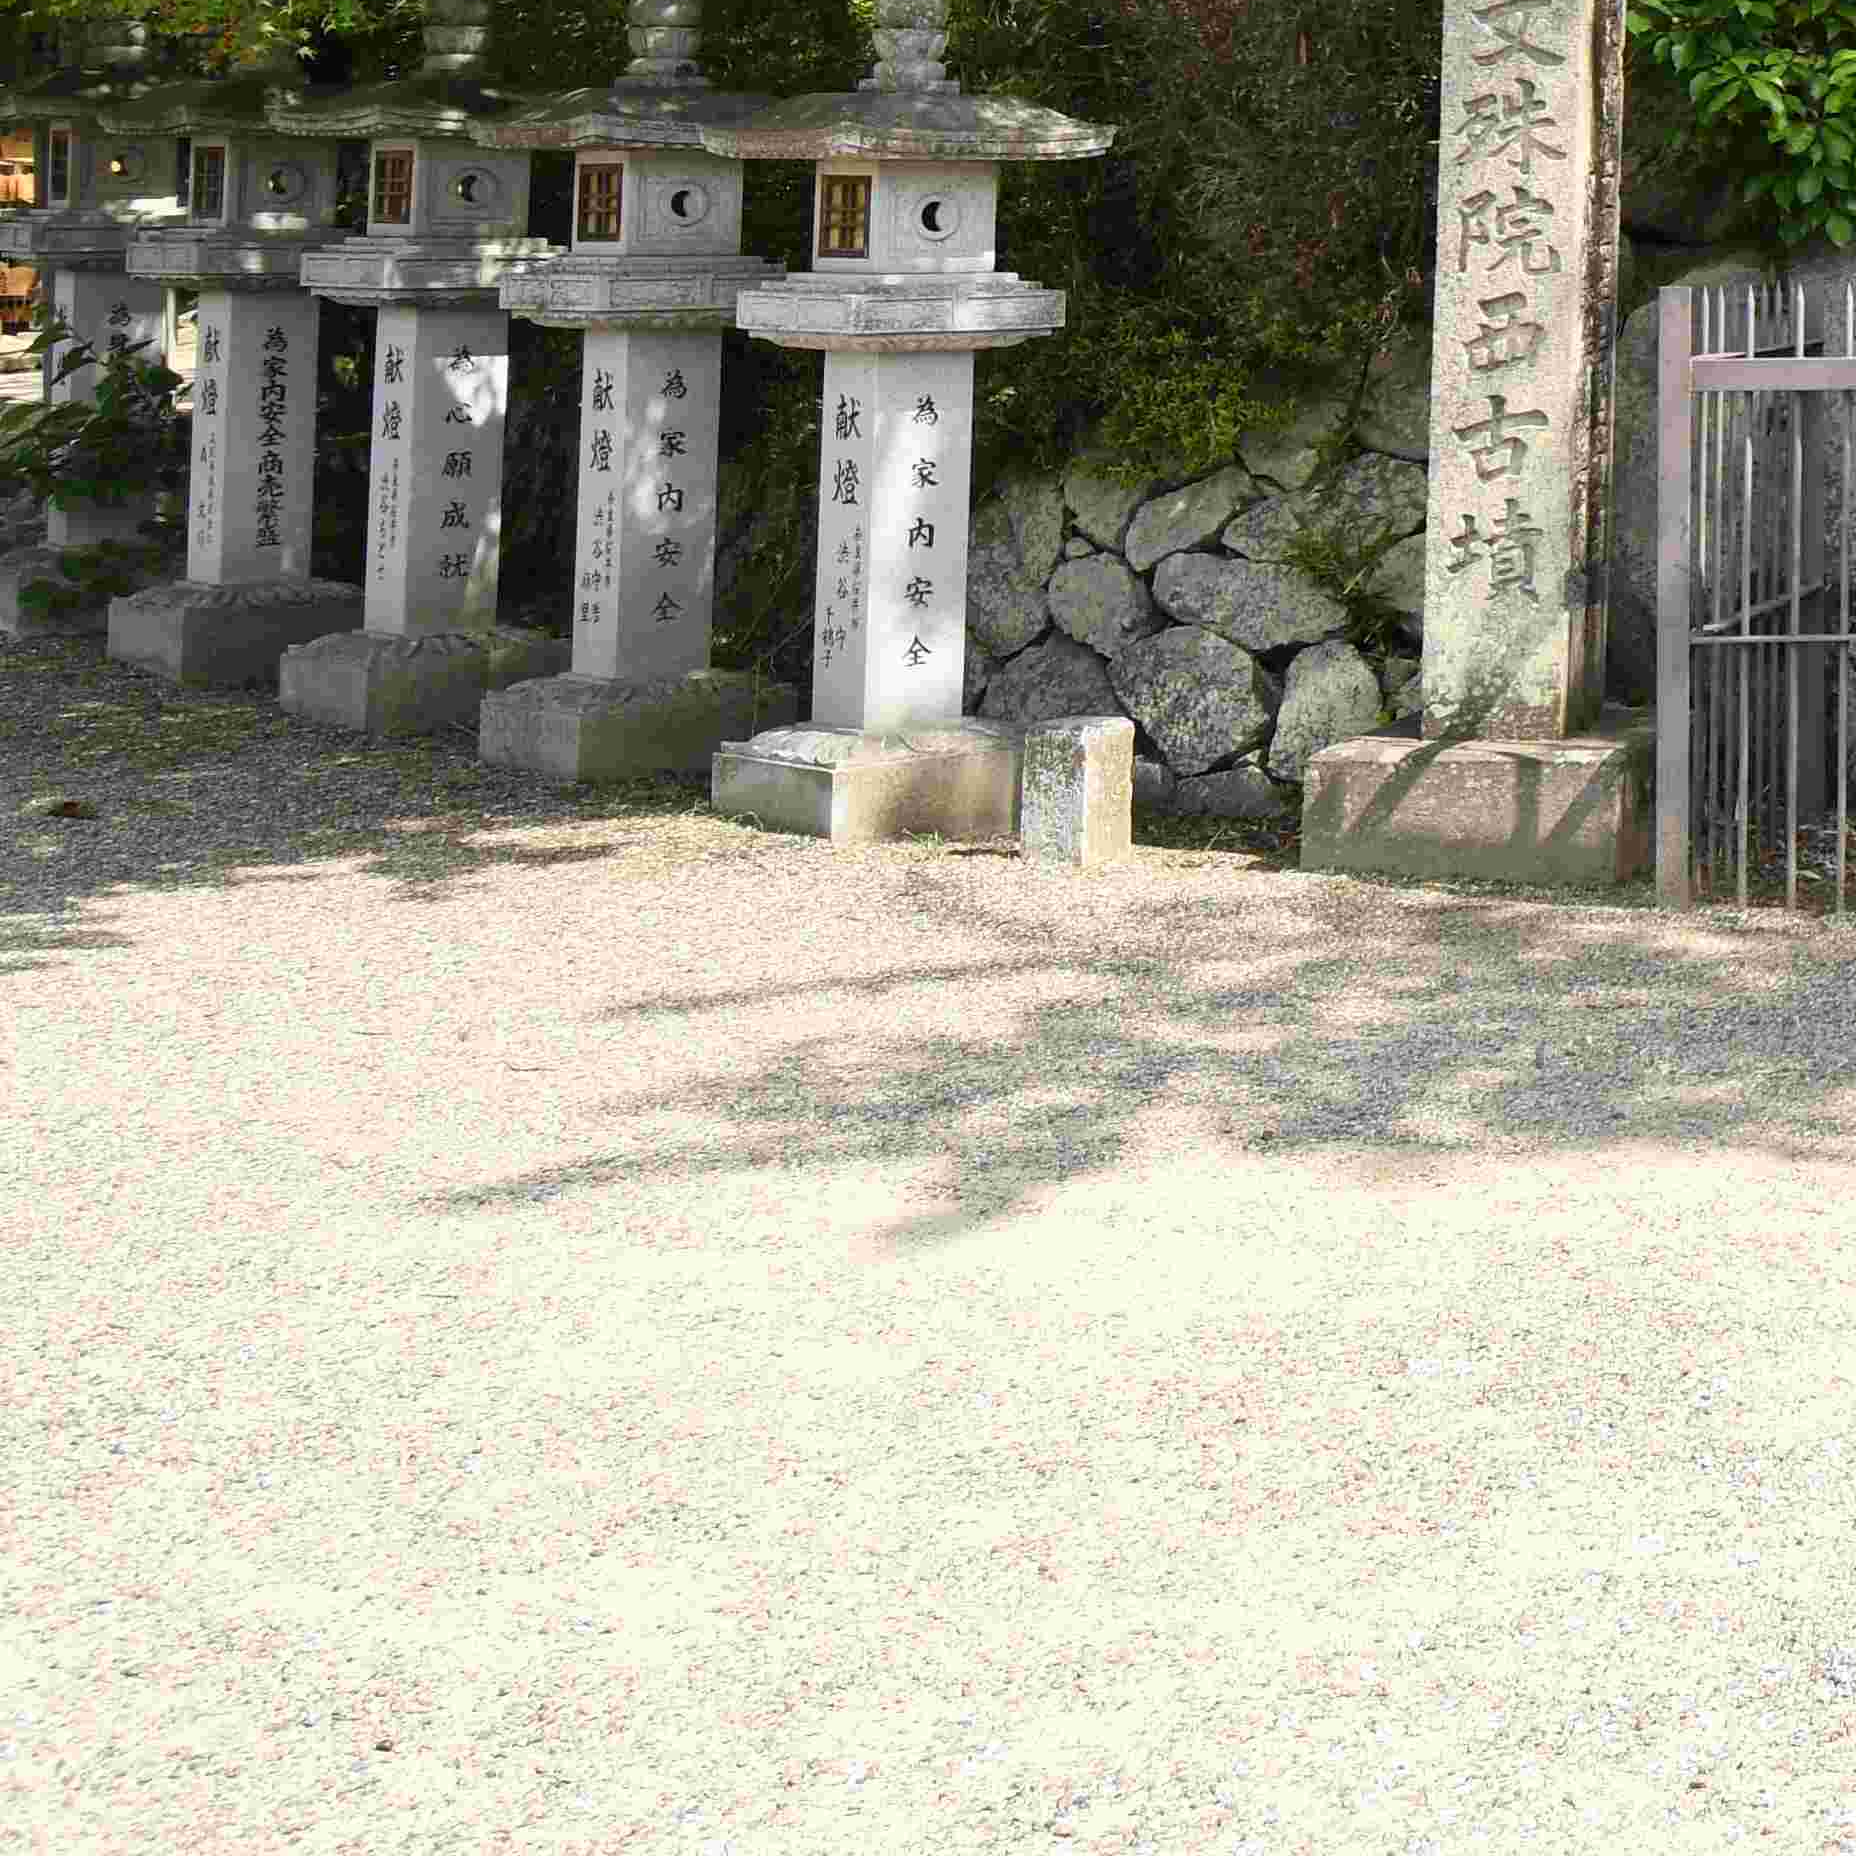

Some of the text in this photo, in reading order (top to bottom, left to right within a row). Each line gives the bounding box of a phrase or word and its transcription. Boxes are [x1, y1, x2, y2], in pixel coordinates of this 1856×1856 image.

[651, 369, 689, 624] 為家内安全
[903, 394, 939, 667] 為家内安全
